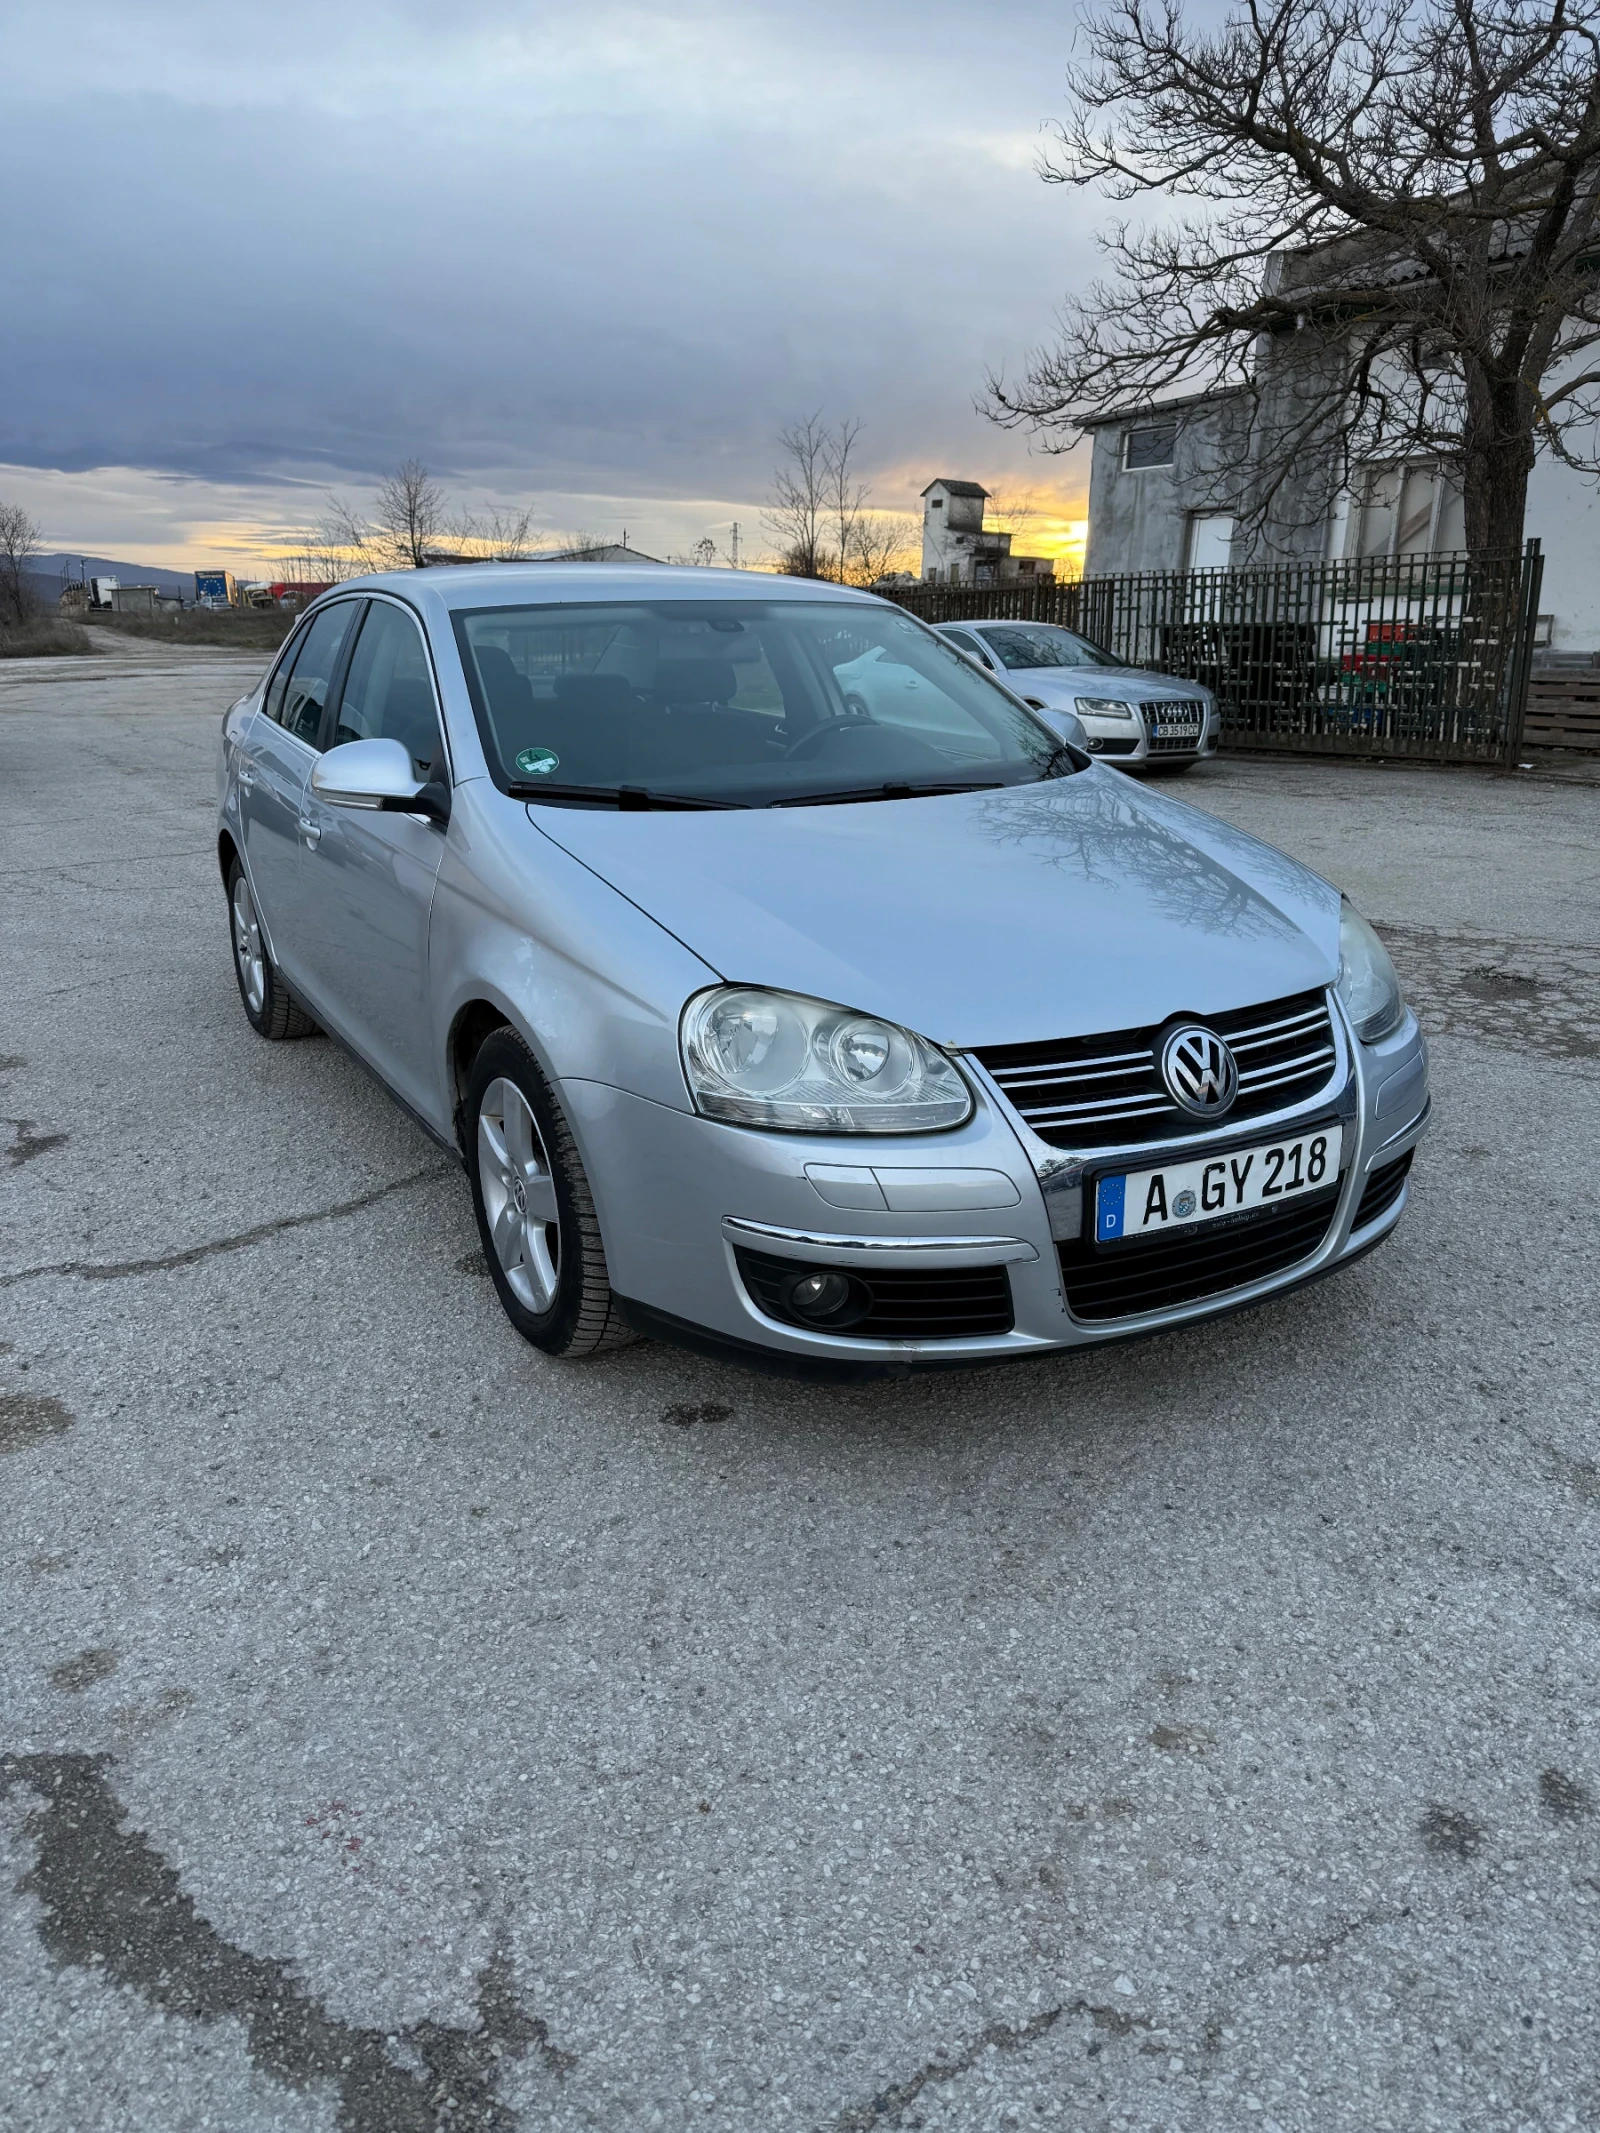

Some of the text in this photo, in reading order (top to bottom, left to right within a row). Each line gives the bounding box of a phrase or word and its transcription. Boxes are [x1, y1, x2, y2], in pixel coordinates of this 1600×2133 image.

[1158, 725, 1168, 736] CB
[1170, 725, 1187, 736] 3519
[1166, 1028, 1234, 1113] VW
[1142, 1174, 1168, 1225] A
[1201, 1154, 1254, 1212] GY
[1261, 1136, 1327, 1198] 218
[1105, 1214, 1116, 1229] D
